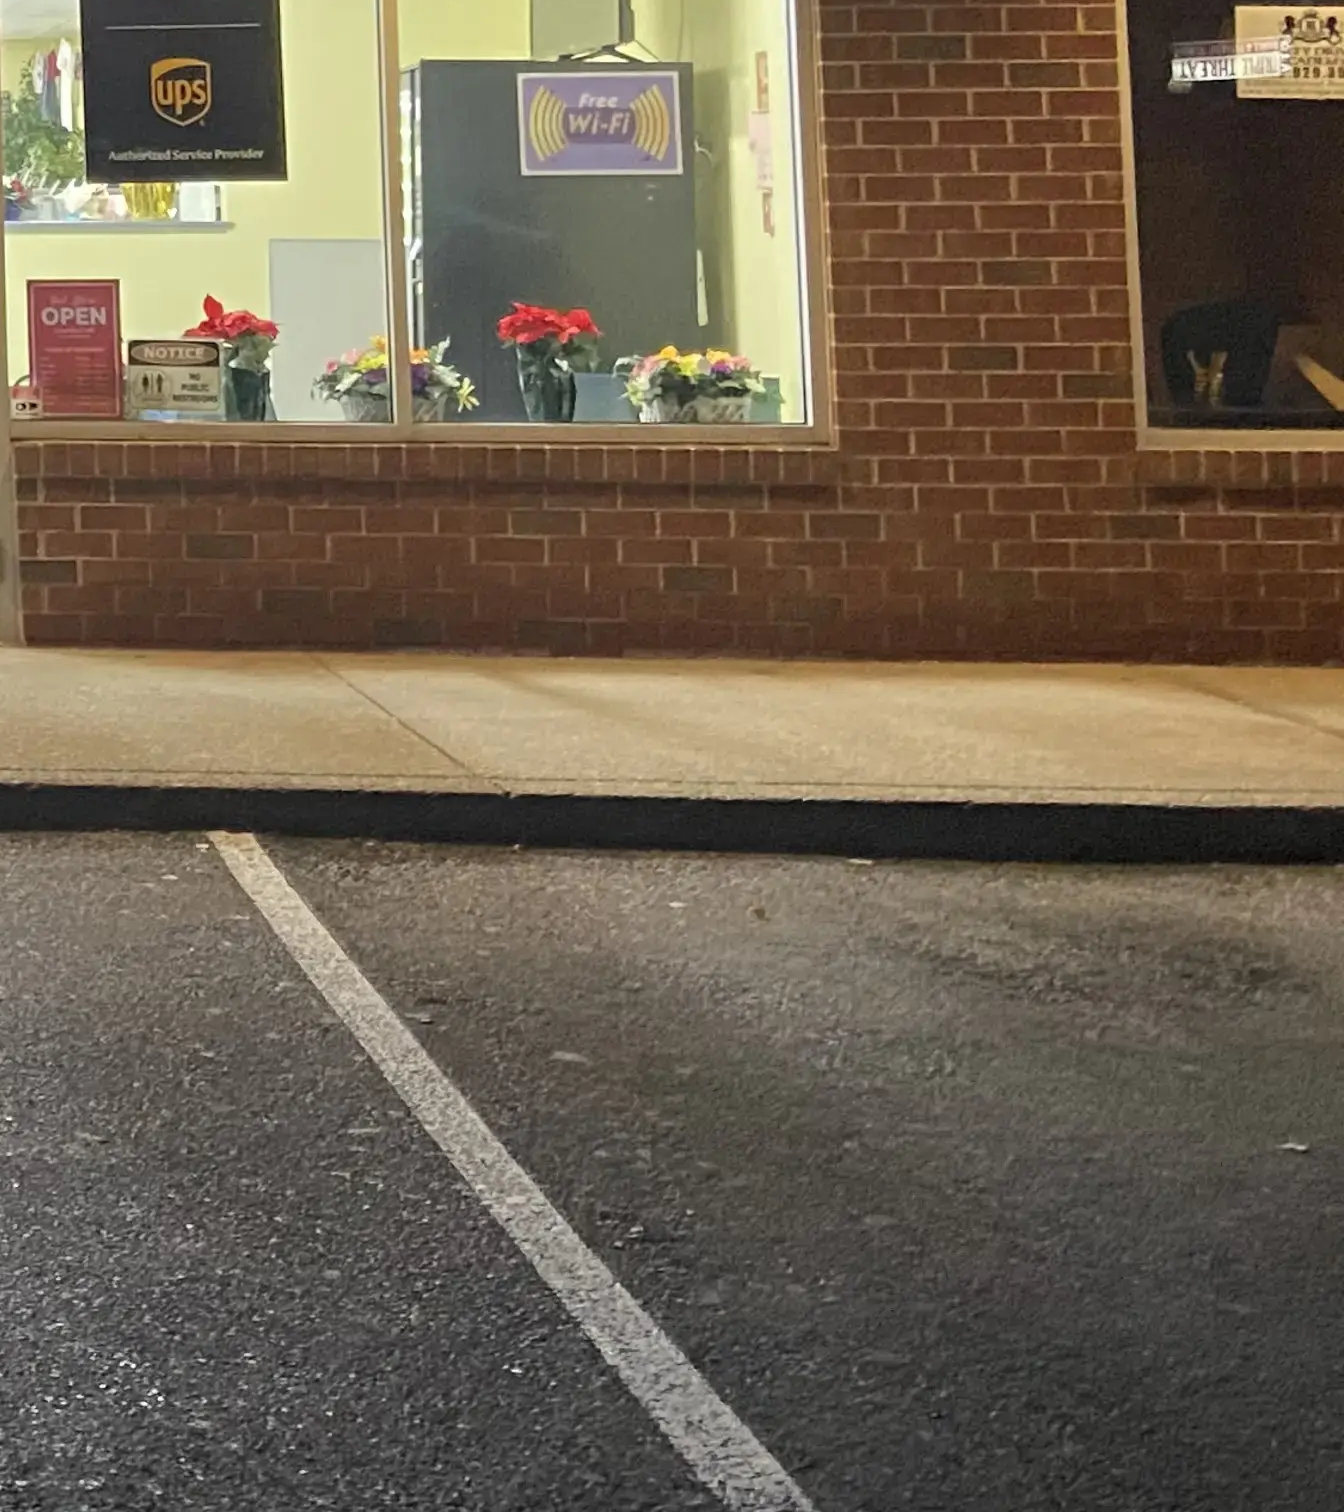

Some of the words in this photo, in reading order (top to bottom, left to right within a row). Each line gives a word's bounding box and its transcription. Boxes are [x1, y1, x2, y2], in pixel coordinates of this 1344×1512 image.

[156, 78, 206, 115] ups
[578, 93, 618, 108] Free
[568, 110, 631, 135] Wi-Fi
[172, 149, 213, 161] Service
[214, 148, 265, 161] Provider
[41, 306, 108, 326] OPEN
[143, 346, 205, 360] NOTICE
